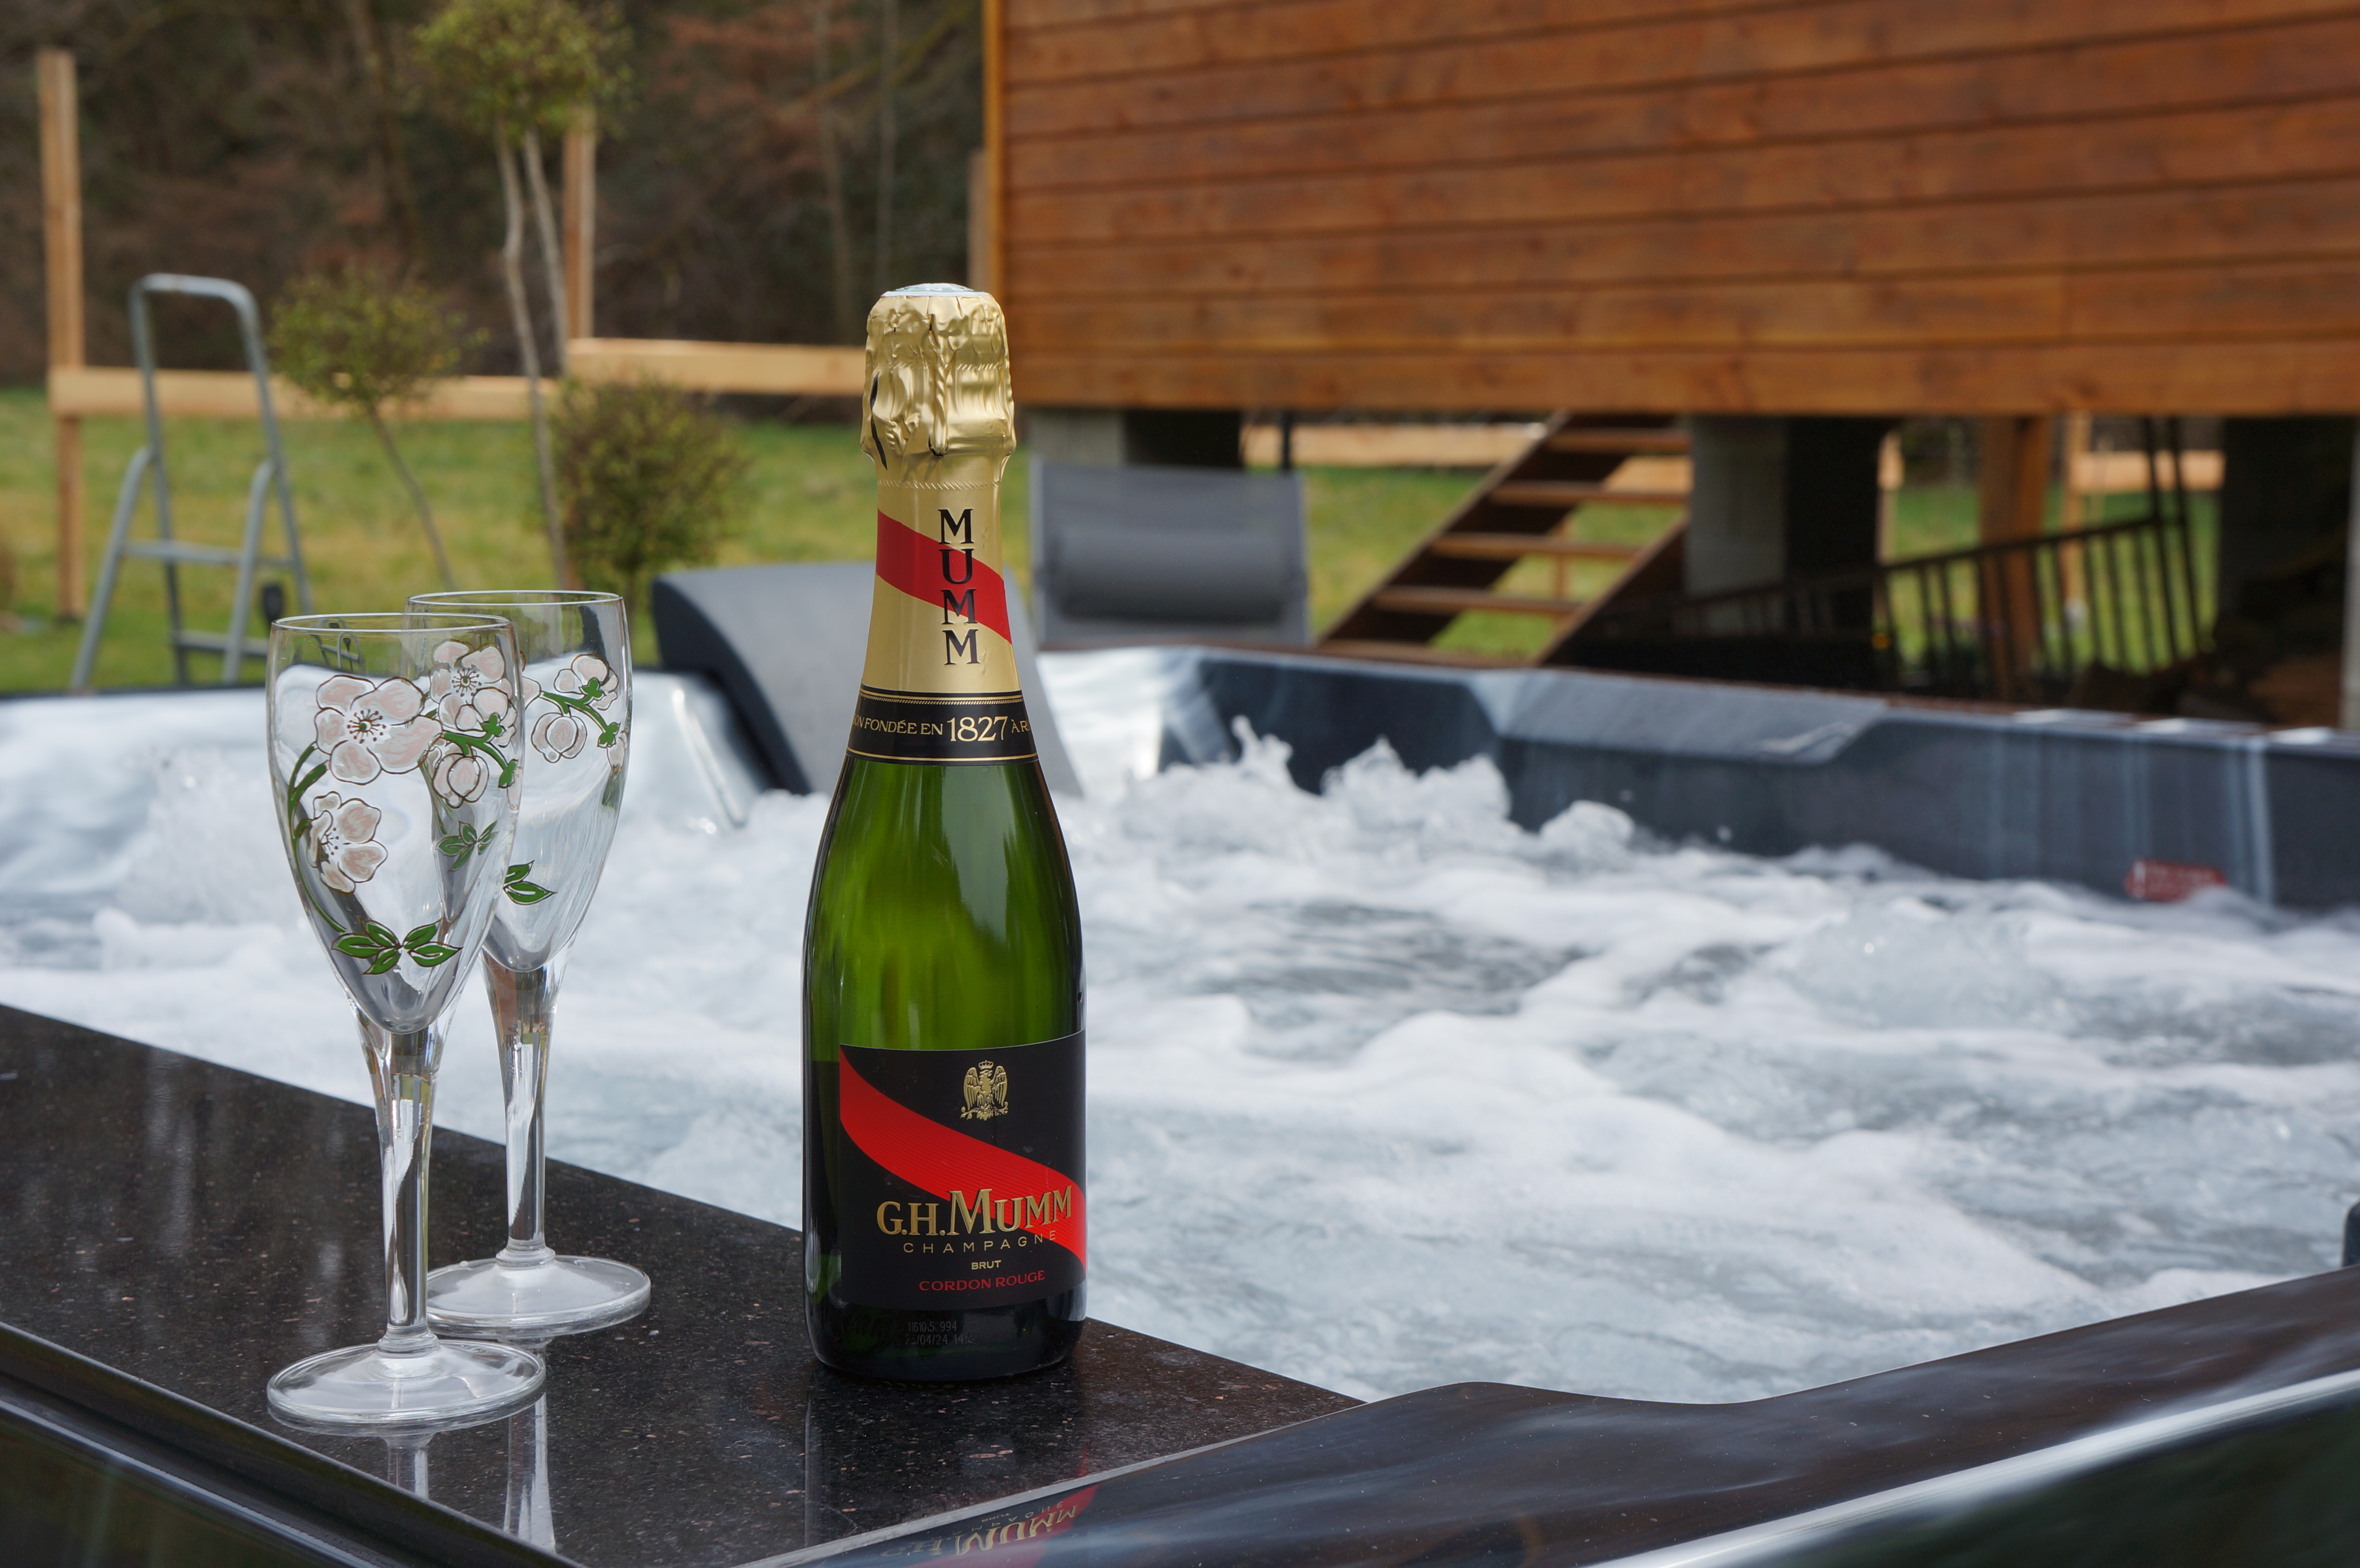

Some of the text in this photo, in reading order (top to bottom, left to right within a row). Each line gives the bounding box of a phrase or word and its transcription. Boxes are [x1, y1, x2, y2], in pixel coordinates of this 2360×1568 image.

[937, 508, 981, 666] MUMM
[864, 717, 918, 735] FONDÉE
[921, 723, 944, 735] EN
[946, 716, 1008, 742] 1827
[903, 1230, 1057, 1254] CHAMPAGNE
[971, 1260, 1002, 1270] BRUT
[919, 1270, 1045, 1291] CORDON ROUGE
